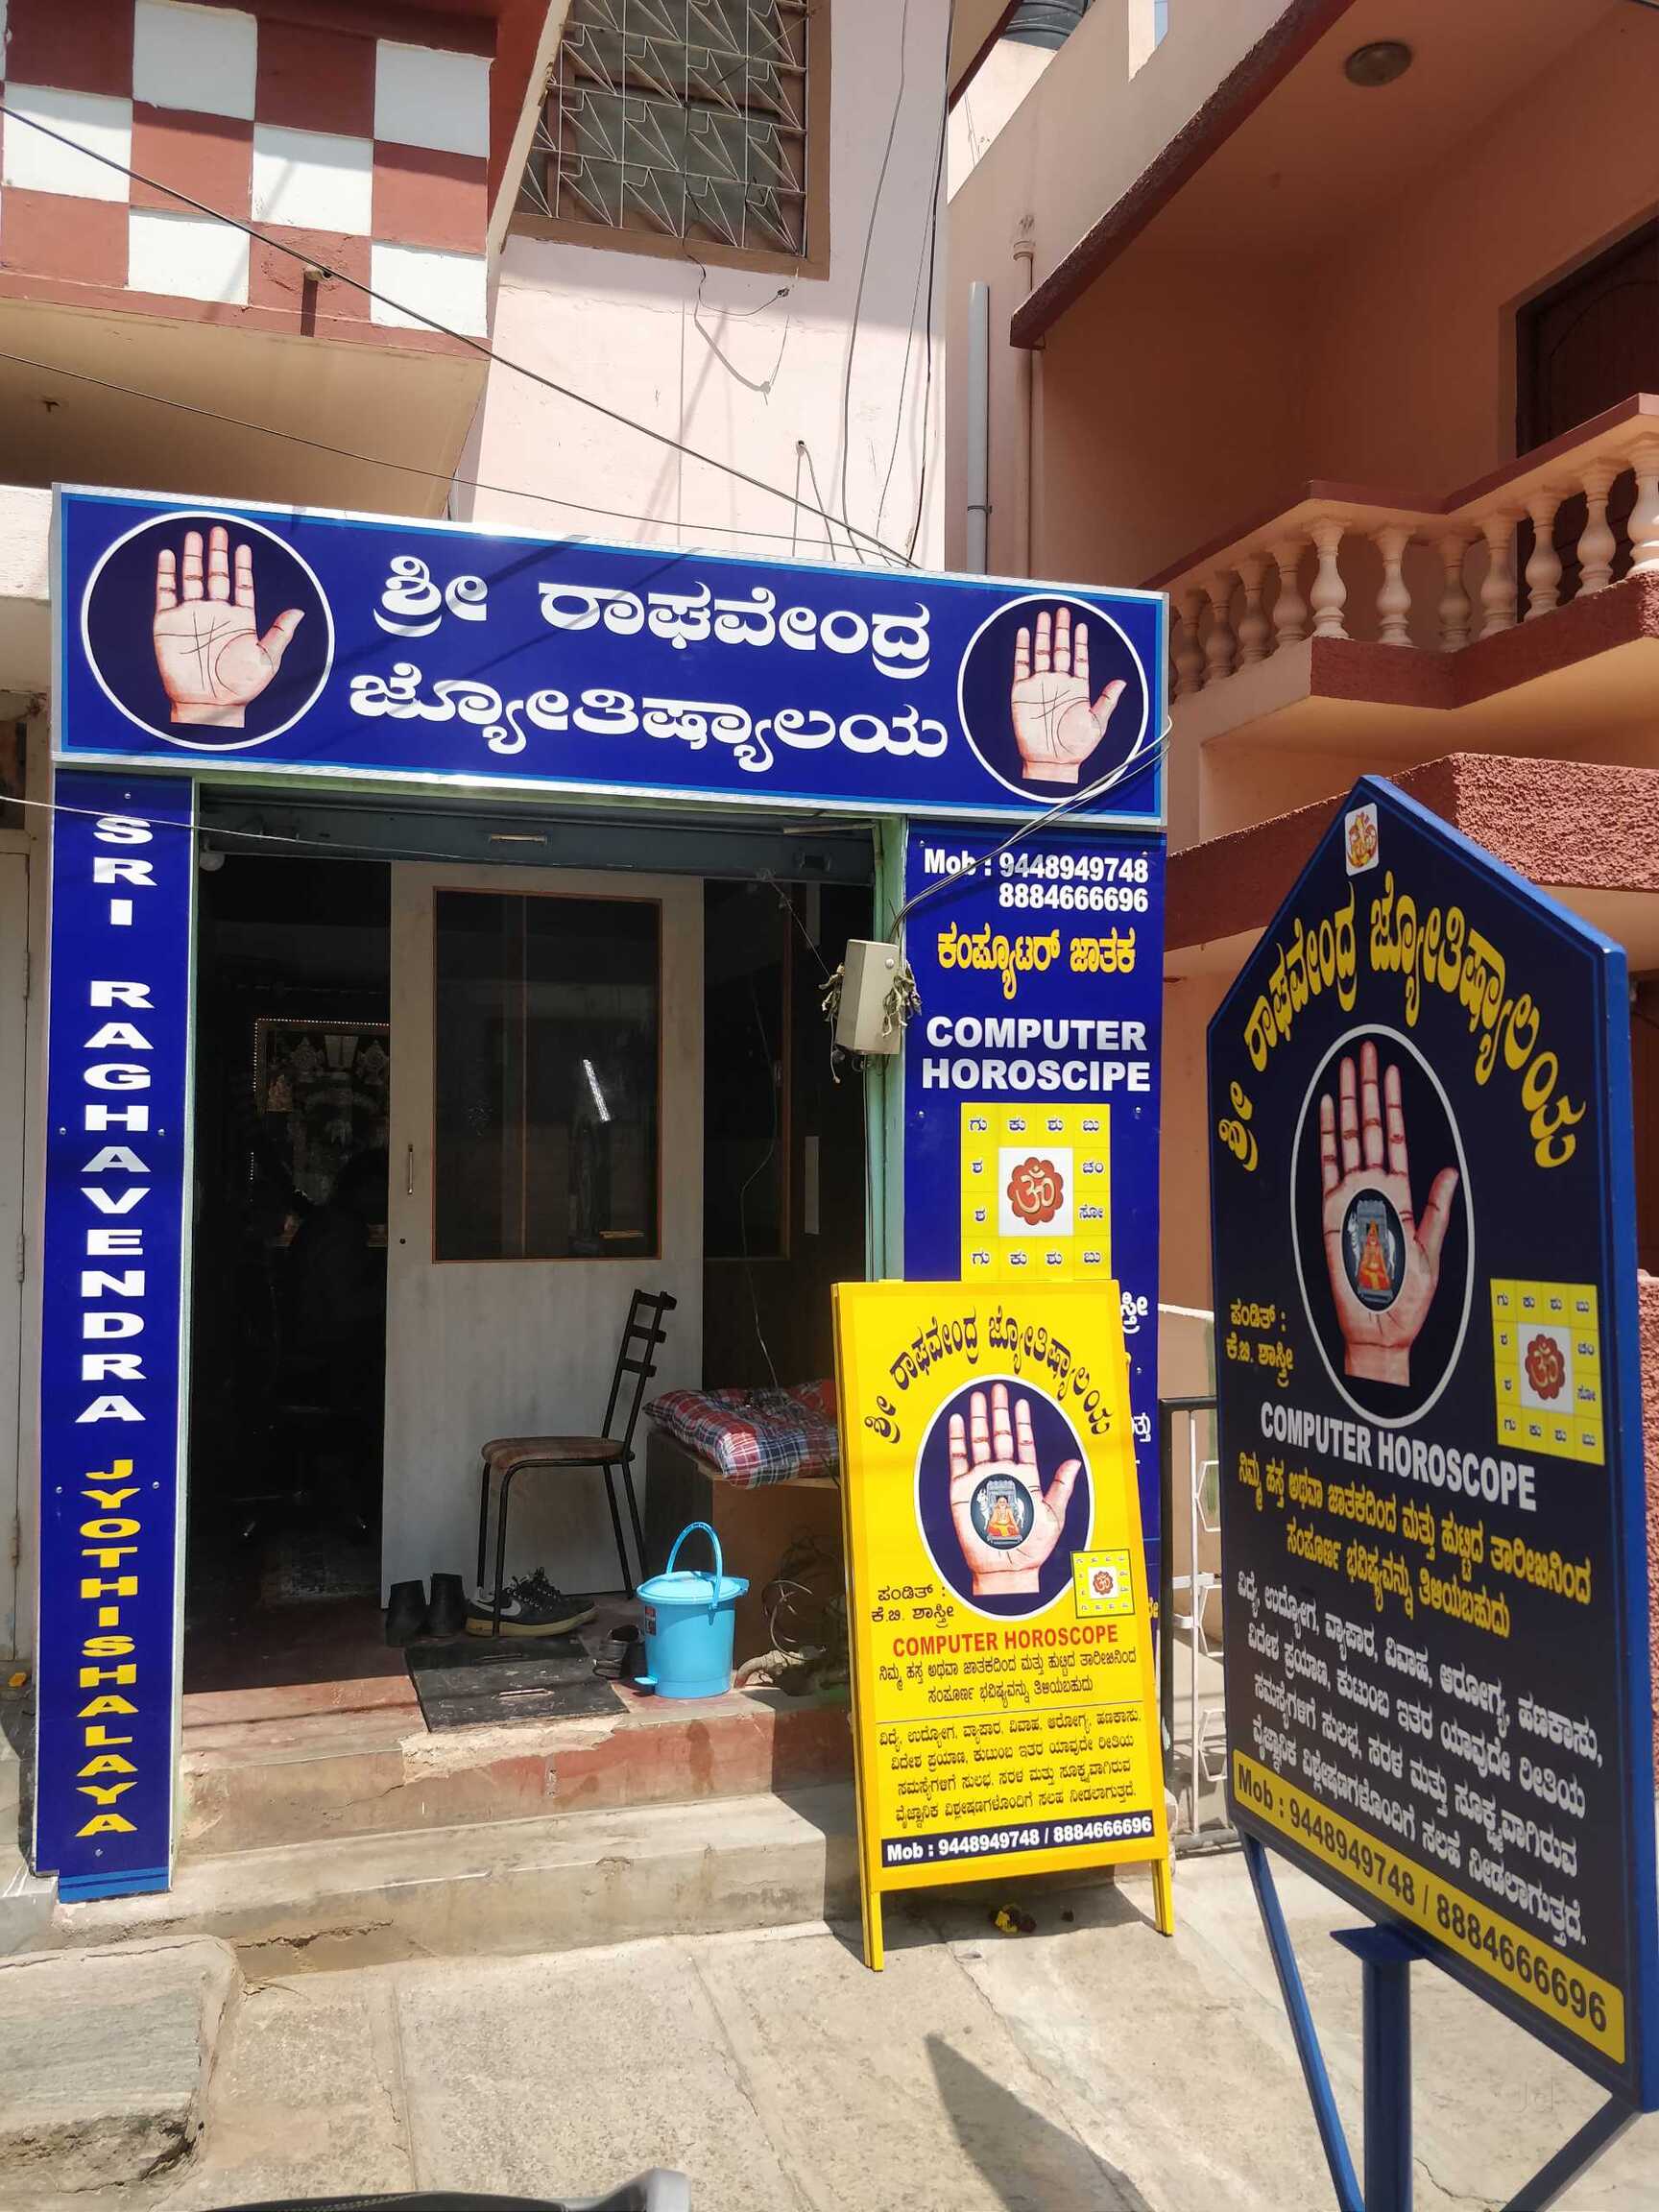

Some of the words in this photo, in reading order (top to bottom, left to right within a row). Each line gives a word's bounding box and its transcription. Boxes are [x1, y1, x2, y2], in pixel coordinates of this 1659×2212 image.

[373, 555, 487, 637] ಶ್ರೀ
[538, 581, 930, 680] ರಾಘವೇಂದ್ರ
[349, 662, 948, 772] ಜ್ಯೋತಿಷ್ಯಾಲಯ
[92, 817, 157, 926] SRI
[924, 849, 976, 876] Mob
[999, 853, 1148, 882] 9448949748
[998, 883, 1148, 912] 8884666696
[938, 922, 1060, 999] ಕಂಪ್ಯೂಟರ್
[1070, 926, 1136, 973] ಜಾತಕ
[926, 1016, 1146, 1051] COMPUTER
[1218, 1081, 1258, 1171] ಶ್ರೀ
[1244, 881, 1358, 1072] ರಾಘವೇಂದ್ರ
[1370, 870, 1586, 1168] ಜ್ಯೋತಿಷ್ಯಾಲಯ
[922, 1058, 1151, 1092] HOROSCIPE
[75, 980, 155, 1423] RAGHAVENDRA
[1230, 1298, 1275, 1329] ಪಂಡಿತ್
[865, 1395, 901, 1444] ಶ್ರೀ
[889, 1306, 979, 1391] ರಾಘವೇಂದ್ರ
[989, 1304, 1114, 1436] ಜ್ಯೋತಿಷ್ಯಾಲಯ
[1261, 1401, 1373, 1466] COMPUTER
[1378, 1431, 1536, 1512] HOROSCOPE
[1238, 1452, 1262, 1511] ನಿಮ್ಮ
[1265, 1457, 1285, 1508] ಹಸ್ತ
[1288, 1467, 1323, 1509] ಅಥವಾ
[1328, 1480, 1397, 1533] ಜಾತಕದಿಂದ
[1402, 1498, 1435, 1561] ಮತ್ತು
[1286, 1516, 1341, 1572] ಸಂಪೂರ್ಣ
[878, 1584, 933, 1601] ಪಂಡಿತ್
[75, 1458, 142, 1838] JYOTHISHALAYA
[893, 1632, 998, 1657] COMPUTER
[1004, 1624, 1118, 1649] HOROSCOPE
[879, 1663, 903, 1691] ನಿಮ್ಮ
[906, 1661, 924, 1684] ಹಸ್ತ
[928, 1660, 958, 1679] ಅಥವಾ
[964, 1654, 1017, 1674] ಜಾತಕದಿಂದ
[1021, 1653, 1044, 1674] ಮತ್ತು
[928, 1685, 974, 1703] ಸಂಪೂರ್ಣ
[1029, 1767, 1055, 1786] ಮತ್ತು
[1397, 1697, 1433, 1740] ಇತರ
[1520, 1756, 1586, 1819] ರೀತಿಯ
[1409, 1756, 1449, 1817] ಮತ್ತು
[887, 1842, 924, 1862] Mob
[938, 1830, 1040, 1856] 9448949748
[1053, 1816, 1152, 1843] 8884666696
[1238, 1764, 1274, 1811] Mob
[1289, 1798, 1415, 1906] 9448949748
[1436, 1893, 1607, 2032] 8884666696
